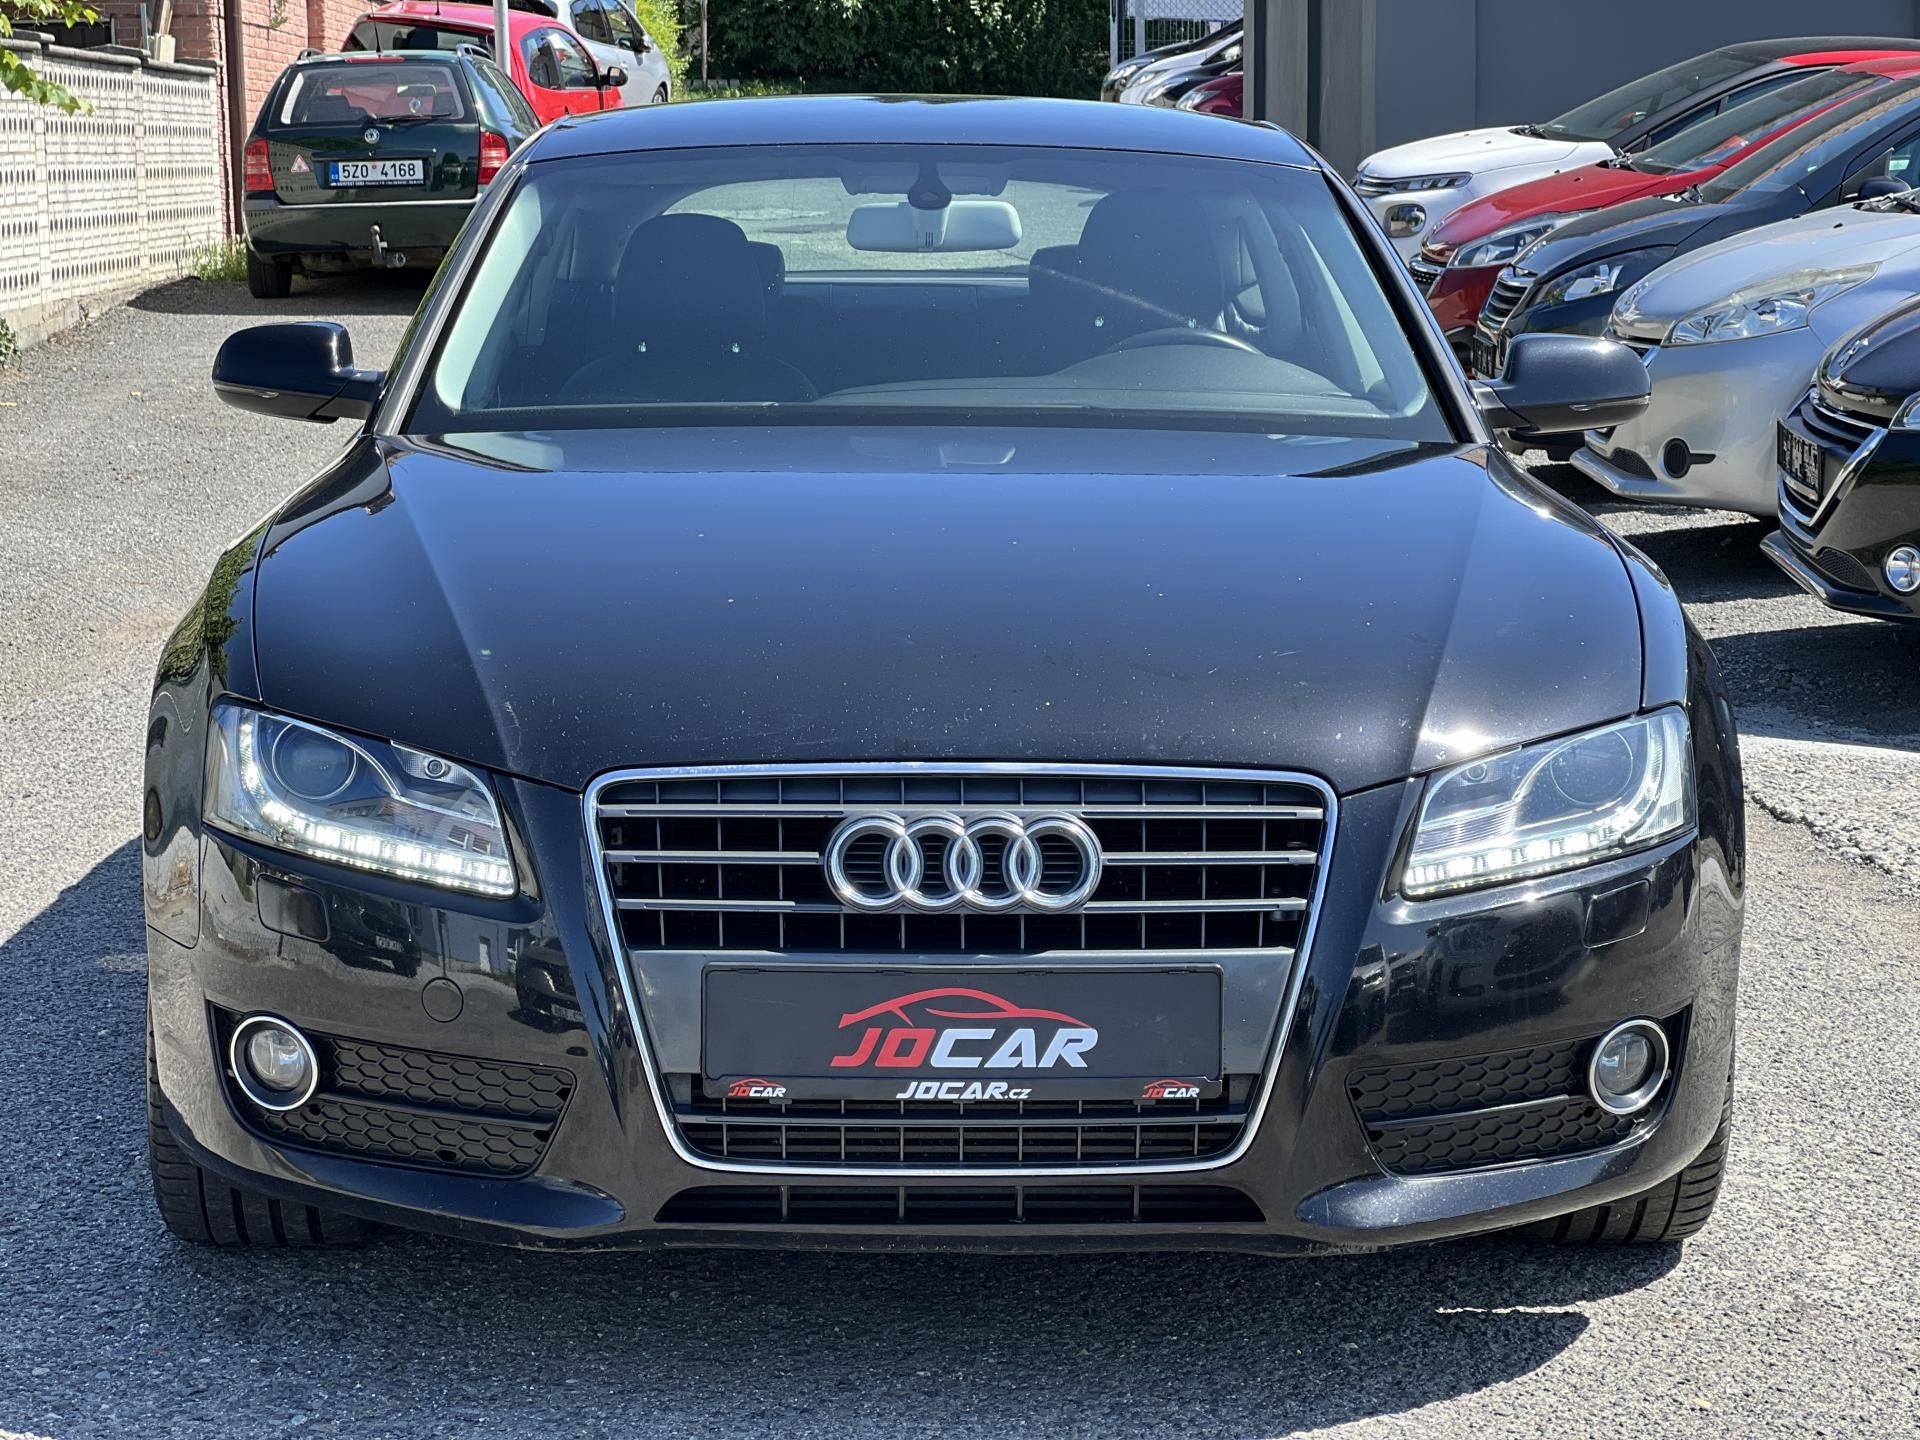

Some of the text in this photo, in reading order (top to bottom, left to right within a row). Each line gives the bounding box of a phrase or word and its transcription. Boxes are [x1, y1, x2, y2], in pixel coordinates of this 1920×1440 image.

[380, 163, 416, 178] 4168
[830, 1028, 1099, 1068] JOCAR
[727, 1087, 787, 1098] JOCAR
[1141, 1087, 1200, 1098] JOCAR
